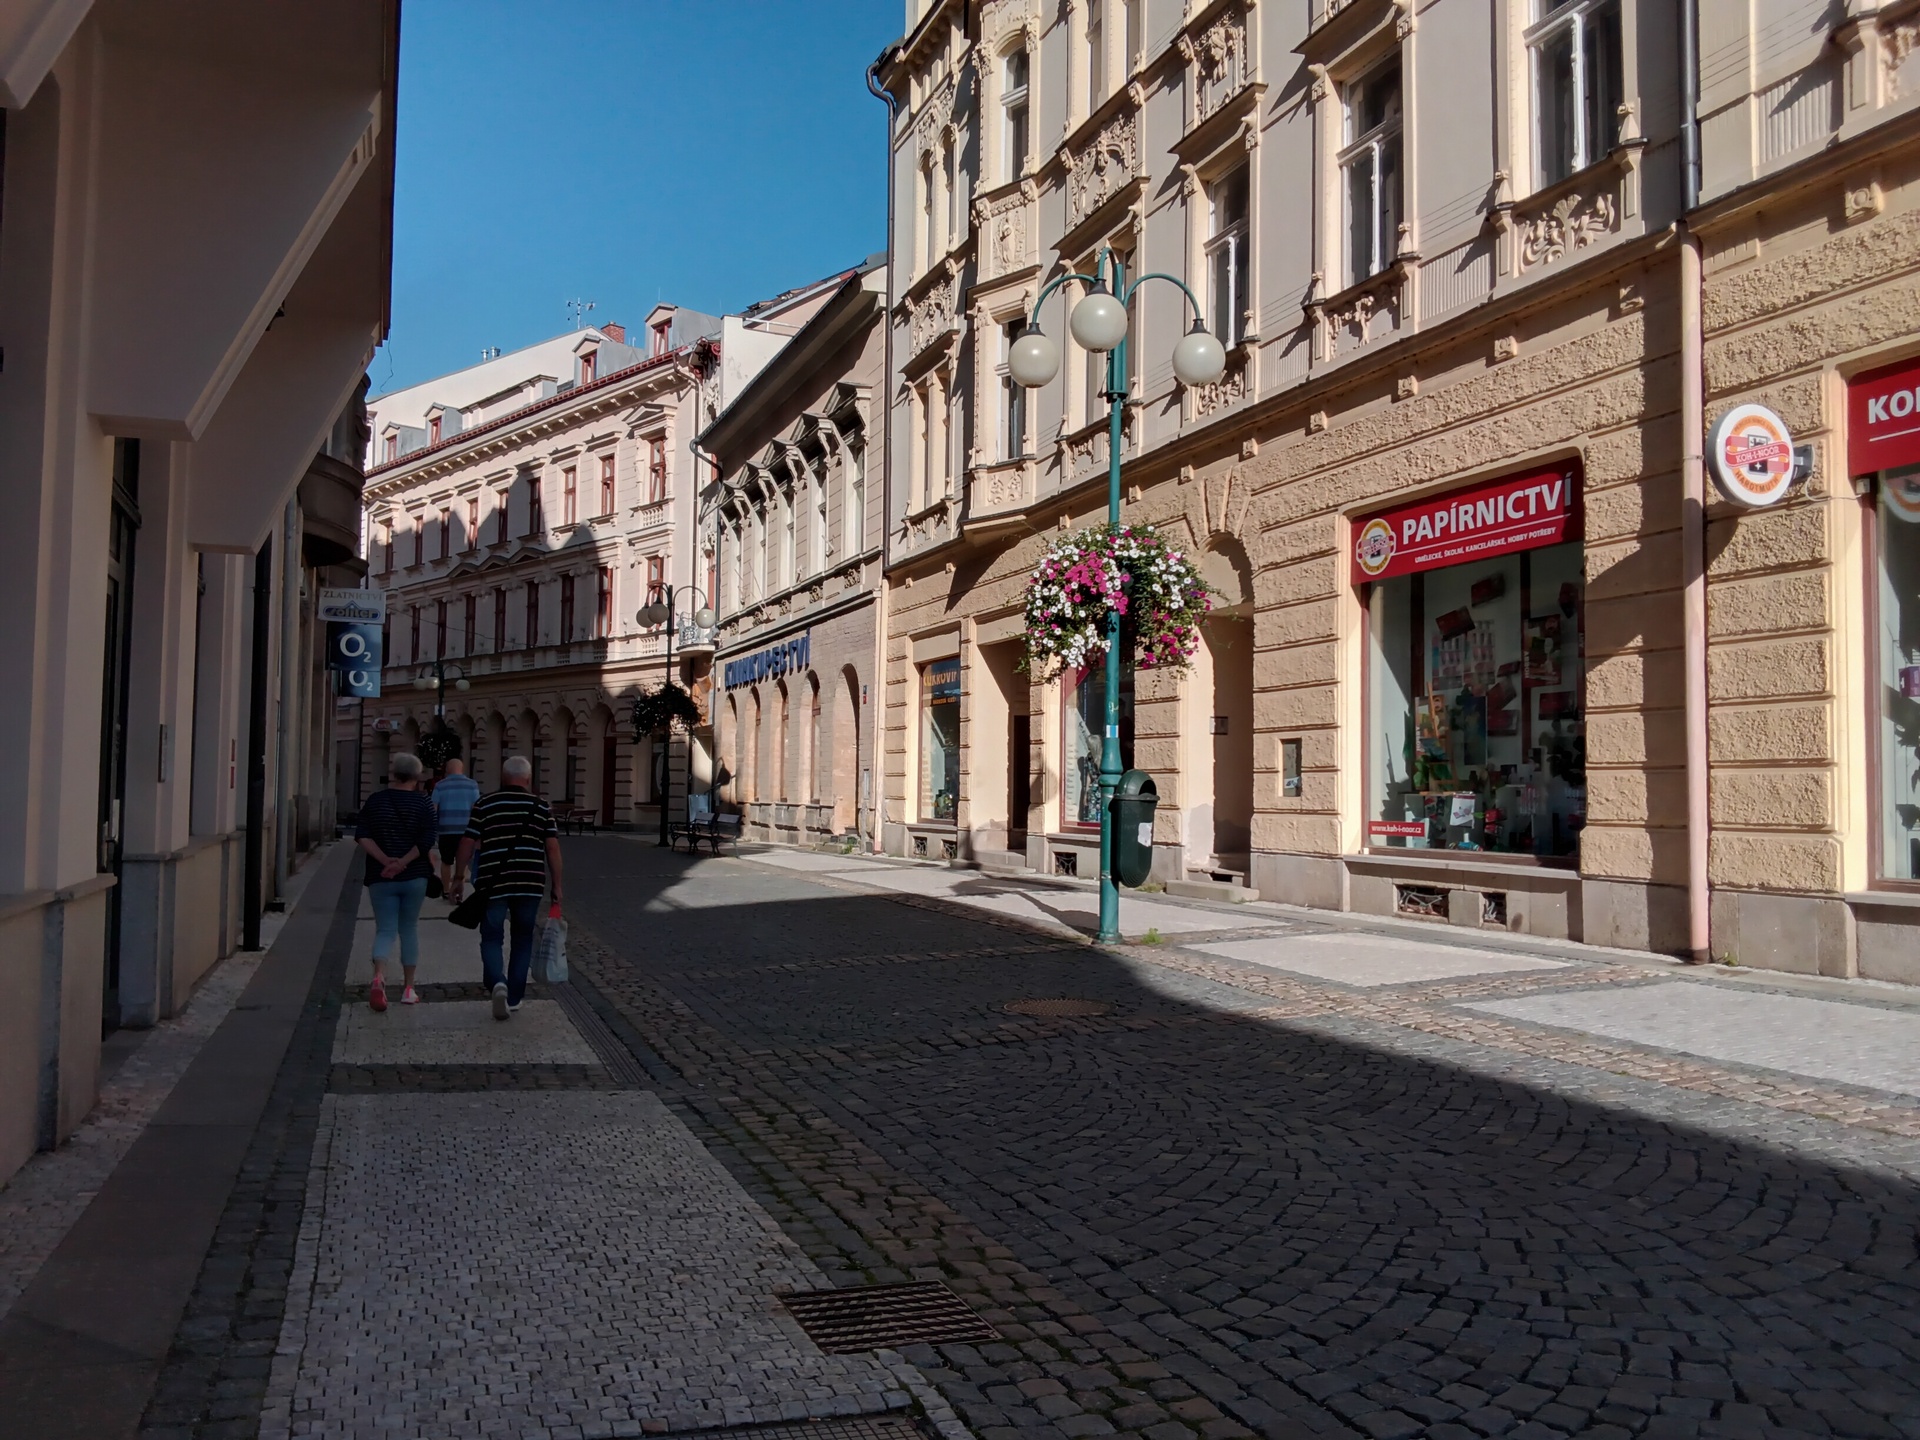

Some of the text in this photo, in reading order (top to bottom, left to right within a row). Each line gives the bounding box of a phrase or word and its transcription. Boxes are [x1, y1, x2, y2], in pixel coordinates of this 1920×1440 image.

[1736, 446, 1780, 463] KOH-I-NOOR
[1735, 471, 1779, 493] HARDTMUTH
[1402, 471, 1573, 545] PAPÍRNICTVÍ
[1507, 533, 1528, 544] HOBBY
[1528, 526, 1556, 539] POTŘEBY
[725, 627, 811, 691] KNIHKUPECTVÍ
